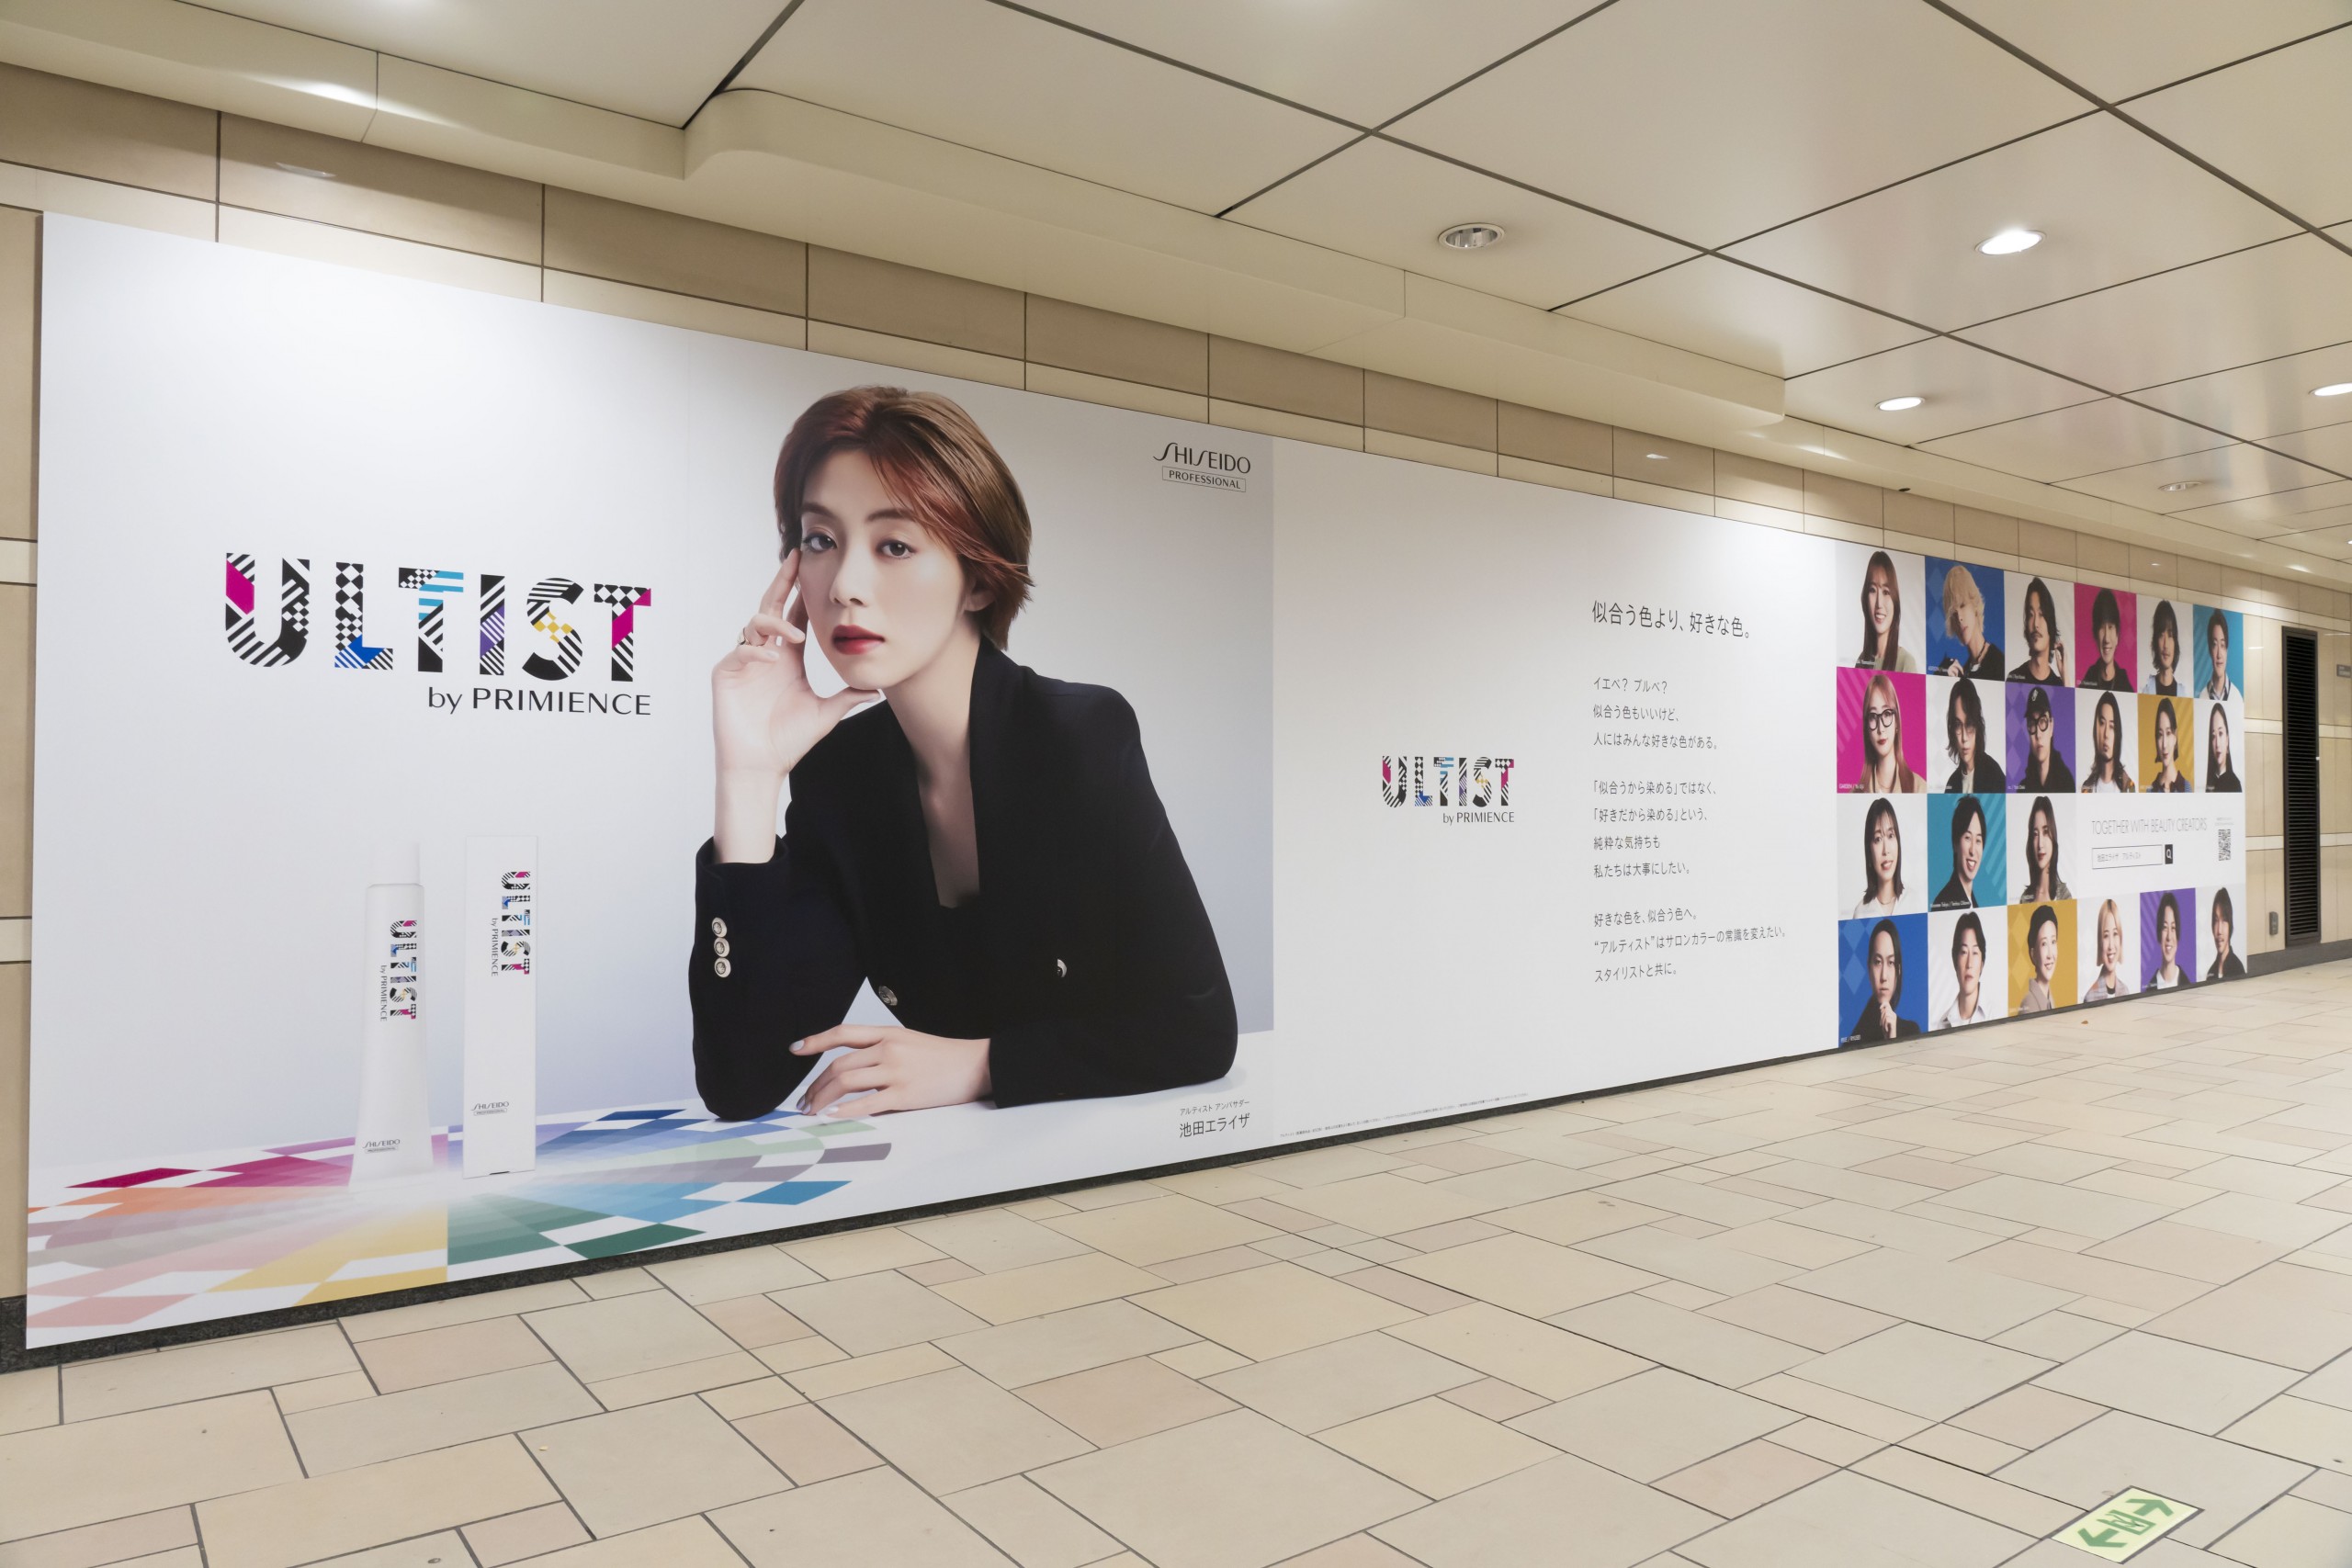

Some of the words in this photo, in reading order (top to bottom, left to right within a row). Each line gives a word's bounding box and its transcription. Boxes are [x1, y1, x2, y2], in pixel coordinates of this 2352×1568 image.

[1153, 442, 1250, 474] SHISEIDO
[1169, 469, 1241, 490] PROFESSIONAL
[225, 552, 651, 682] ULTIST
[1592, 600, 1749, 638] 似合う色より、好きな色。
[428, 686, 463, 715] by
[472, 687, 651, 716] PRIMIENCE
[1593, 704, 1679, 722] 似合う色もいいけど、
[1593, 731, 1717, 750] 人にはみんな好きな色がある。
[1382, 756, 1514, 807] ULTIST
[1442, 813, 1454, 826] by
[1456, 812, 1515, 823] PRIMIENCE
[2092, 819, 2129, 835] TOGETHER
[2131, 818, 2149, 833] WITH
[2151, 818, 2176, 833] BEAUTY
[2177, 818, 2207, 832] CREATORS
[1593, 834, 1660, 851] 純粋な気持ちも
[1593, 861, 1690, 878] 私たちは大事にしたい。
[501, 871, 530, 975] ULTIST
[1594, 908, 1697, 928] 好きな色を、似合う色へ。
[390, 920, 417, 1020] ULTIST
[1594, 962, 1677, 983] スタイリストと共に。
[470, 1101, 509, 1111] SHISEIDO
[1180, 1112, 1250, 1138] 池田エライザ
[363, 1139, 401, 1148] SHISEIDO
